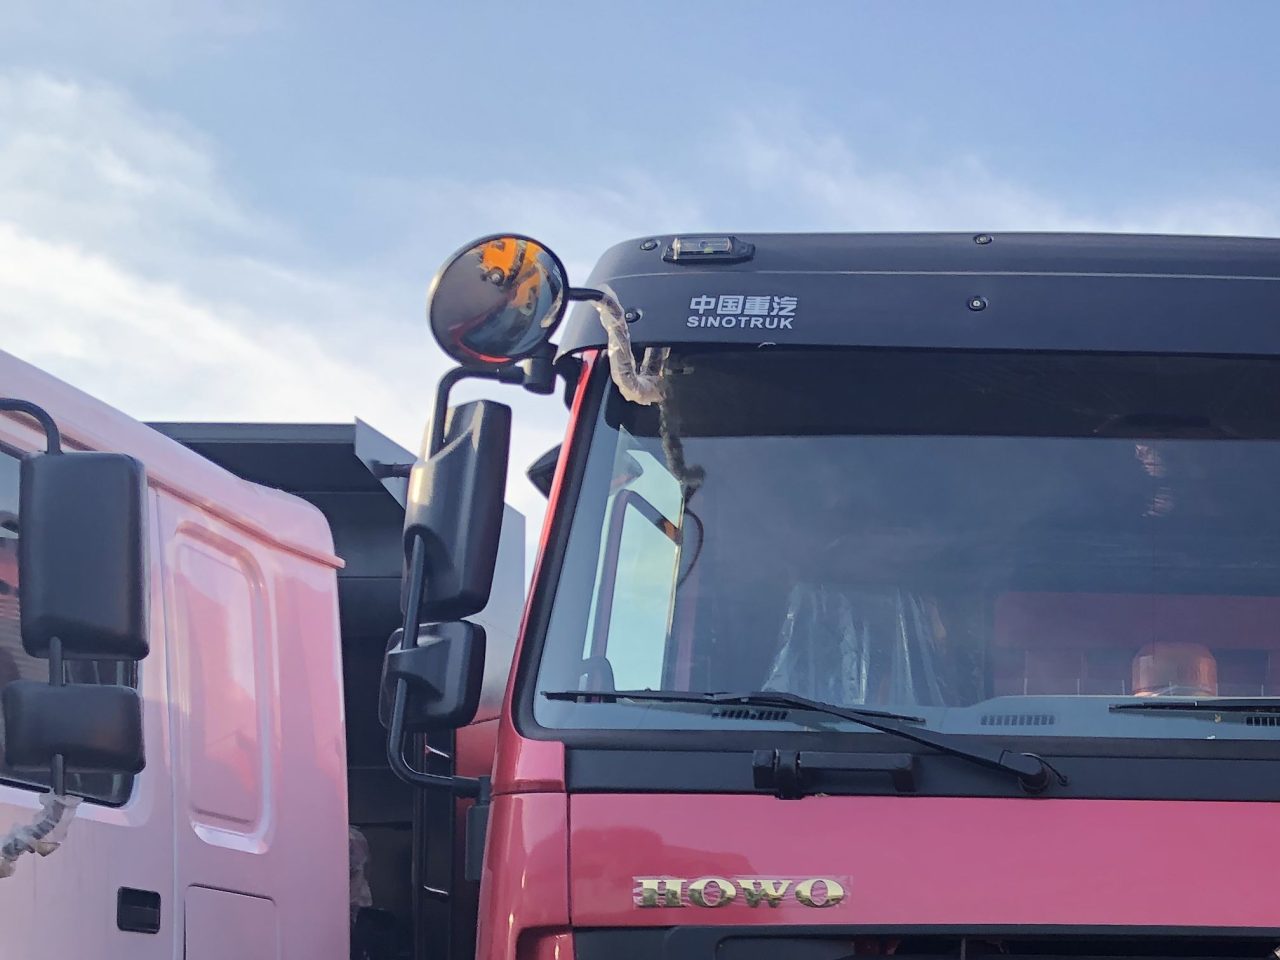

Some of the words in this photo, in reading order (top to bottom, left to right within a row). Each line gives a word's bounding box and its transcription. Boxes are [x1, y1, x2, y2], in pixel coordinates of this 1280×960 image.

[690, 295, 798, 316] 中国重汽
[686, 316, 794, 329] SINOTRUK
[634, 878, 846, 908] HOWO
